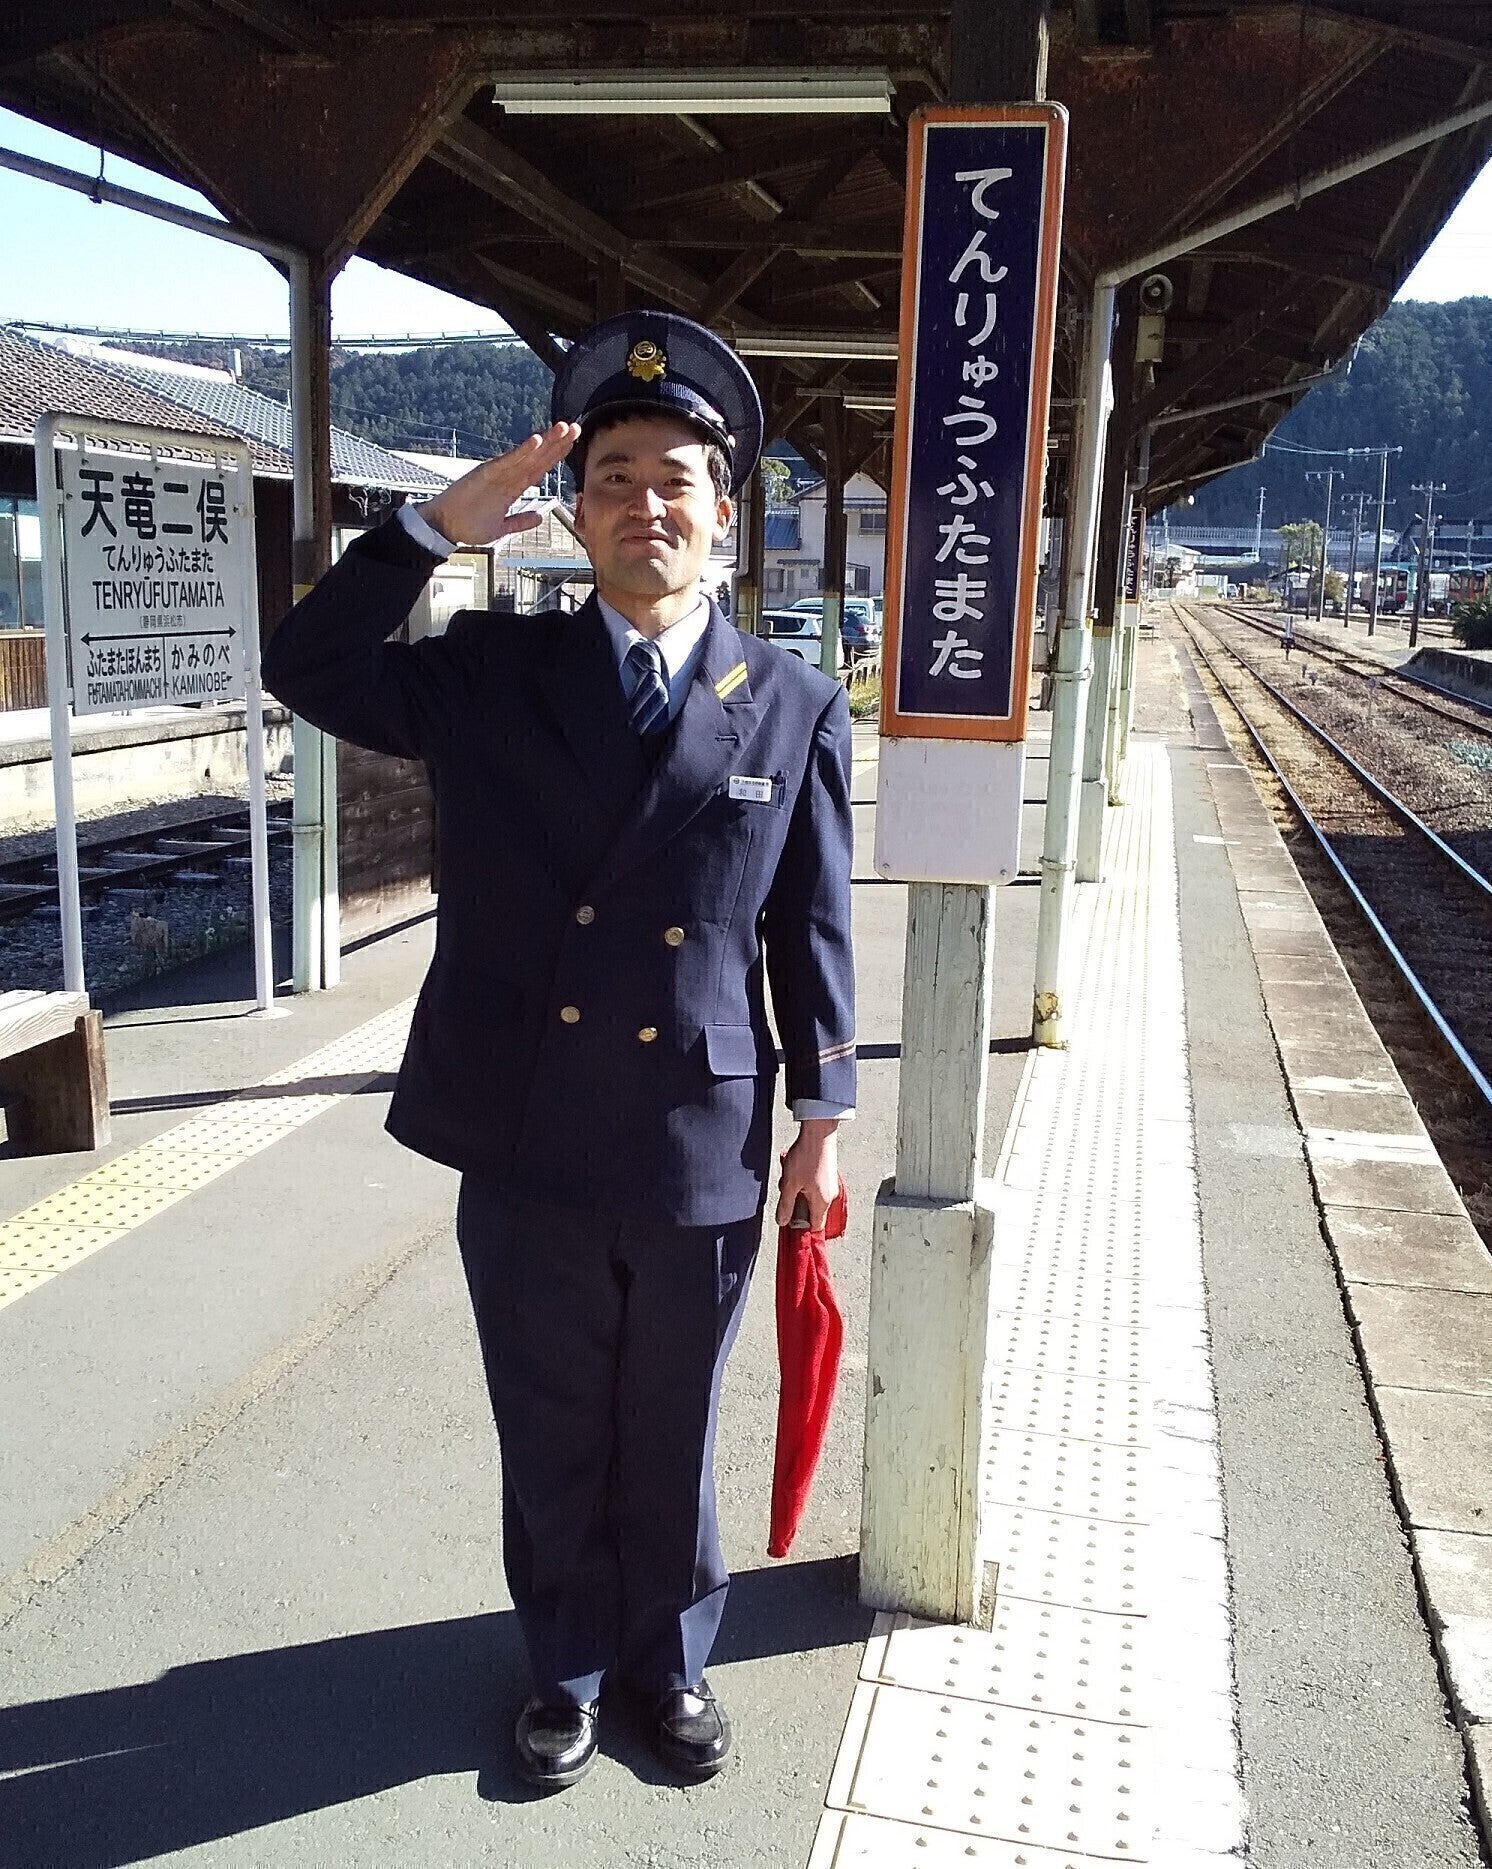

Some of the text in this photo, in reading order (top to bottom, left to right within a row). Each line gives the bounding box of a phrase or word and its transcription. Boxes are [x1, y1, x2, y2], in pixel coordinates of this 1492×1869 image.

[928, 167, 1014, 680] てんりゅうふたまた
[78, 468, 229, 544] 天竜二俣
[102, 544, 215, 574] てんりゅうふたまた
[92, 576, 225, 611] TENRYŪFUTAMATA
[87, 645, 161, 678] ふたまたほんまち
[171, 643, 230, 670] かみのべ
[172, 671, 228, 696] KAMINOBE
